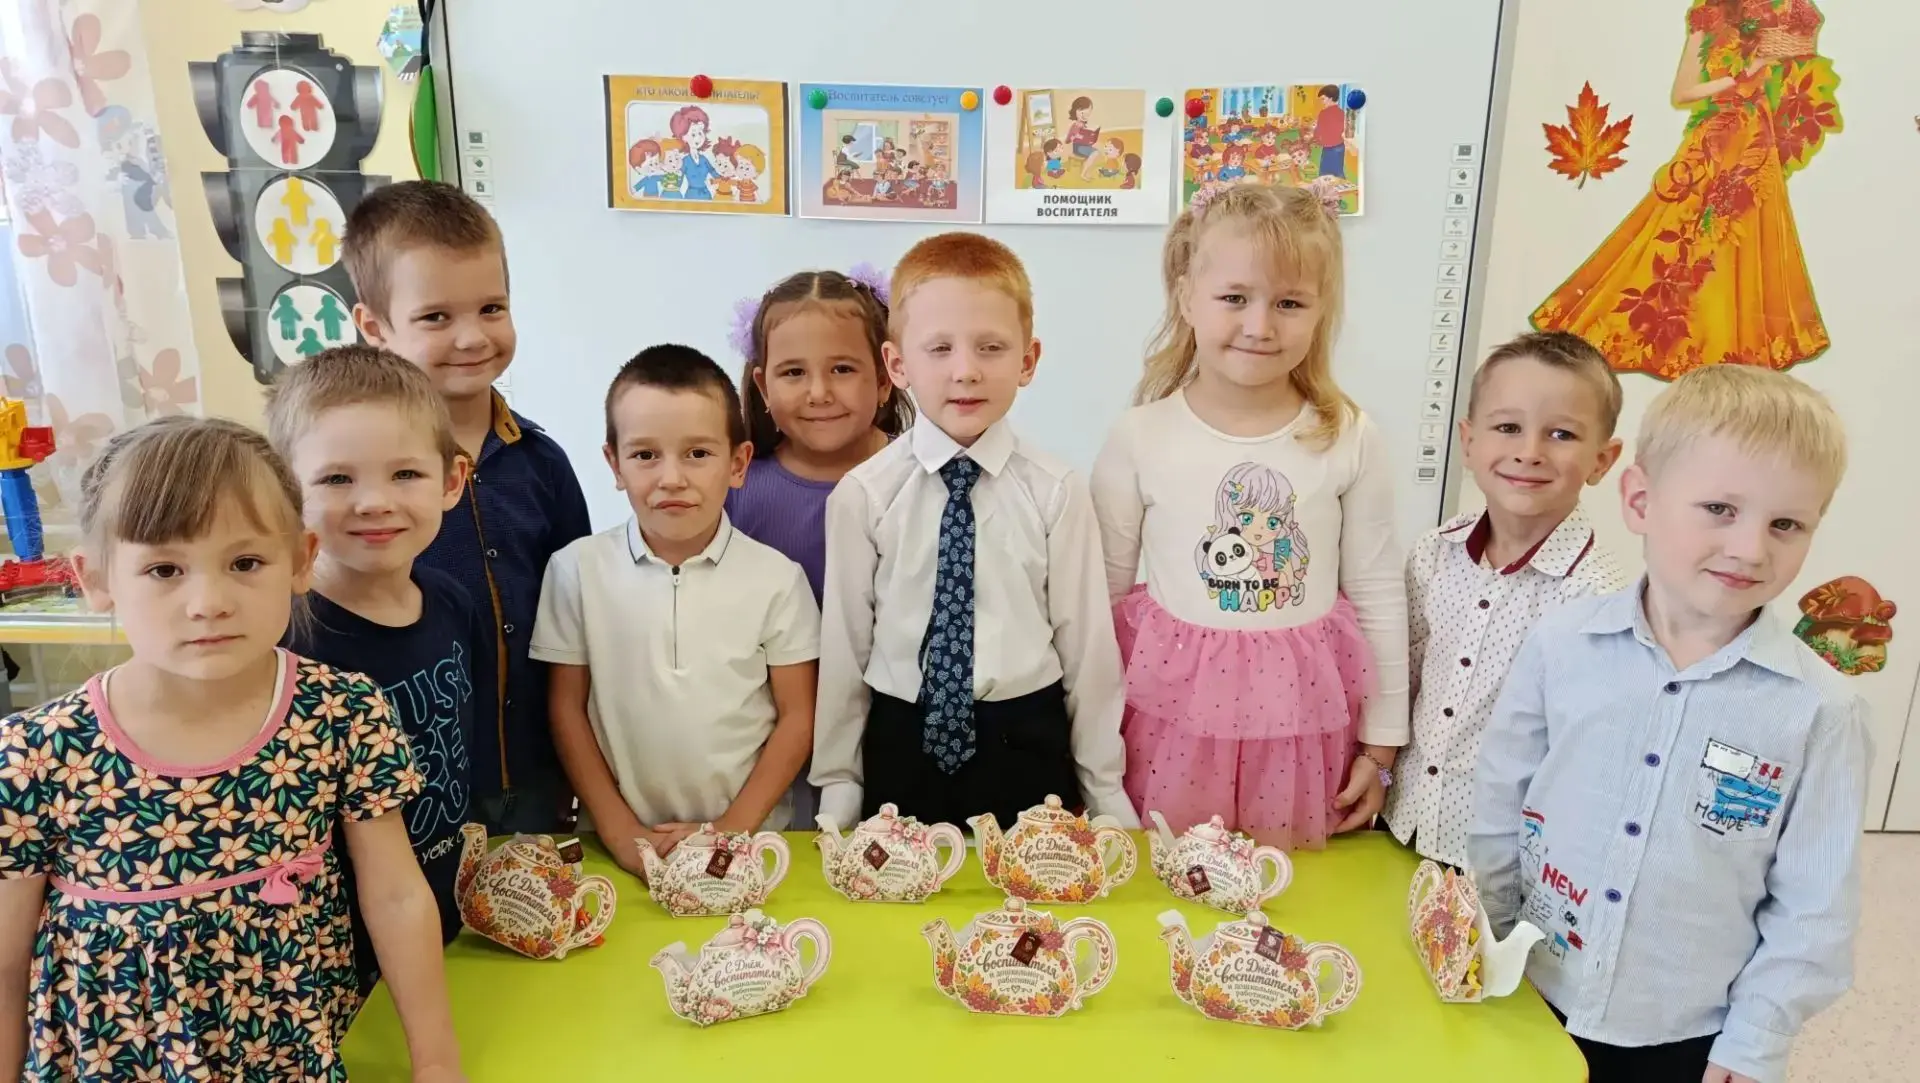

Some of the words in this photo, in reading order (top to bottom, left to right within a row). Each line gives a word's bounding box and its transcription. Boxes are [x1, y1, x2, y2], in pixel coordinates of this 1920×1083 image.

[636, 87, 655, 97] КТО
[1043, 195, 1112, 206] ПОМОЩНИК
[1036, 207, 1118, 217] ВОСПИТАТЕЛЯ
[1208, 578, 1240, 590] BORN
[1244, 580, 1260, 590] TO
[1263, 578, 1279, 589] BE
[1695, 801, 1744, 832] MONDE
[421, 836, 455, 865] YORK
[1035, 838, 1044, 851] С
[1045, 837, 1073, 853] Днём
[1018, 844, 1090, 872] воспитателя
[508, 873, 520, 887] С
[519, 877, 547, 902] Днём
[1541, 862, 1588, 907] NEW
[488, 876, 557, 927] воспитателя
[995, 943, 1004, 958] С
[1234, 957, 1244, 972] С
[1245, 958, 1280, 978] Днём
[708, 968, 783, 989] воспитателя
[1214, 964, 1299, 998] воспитателя
